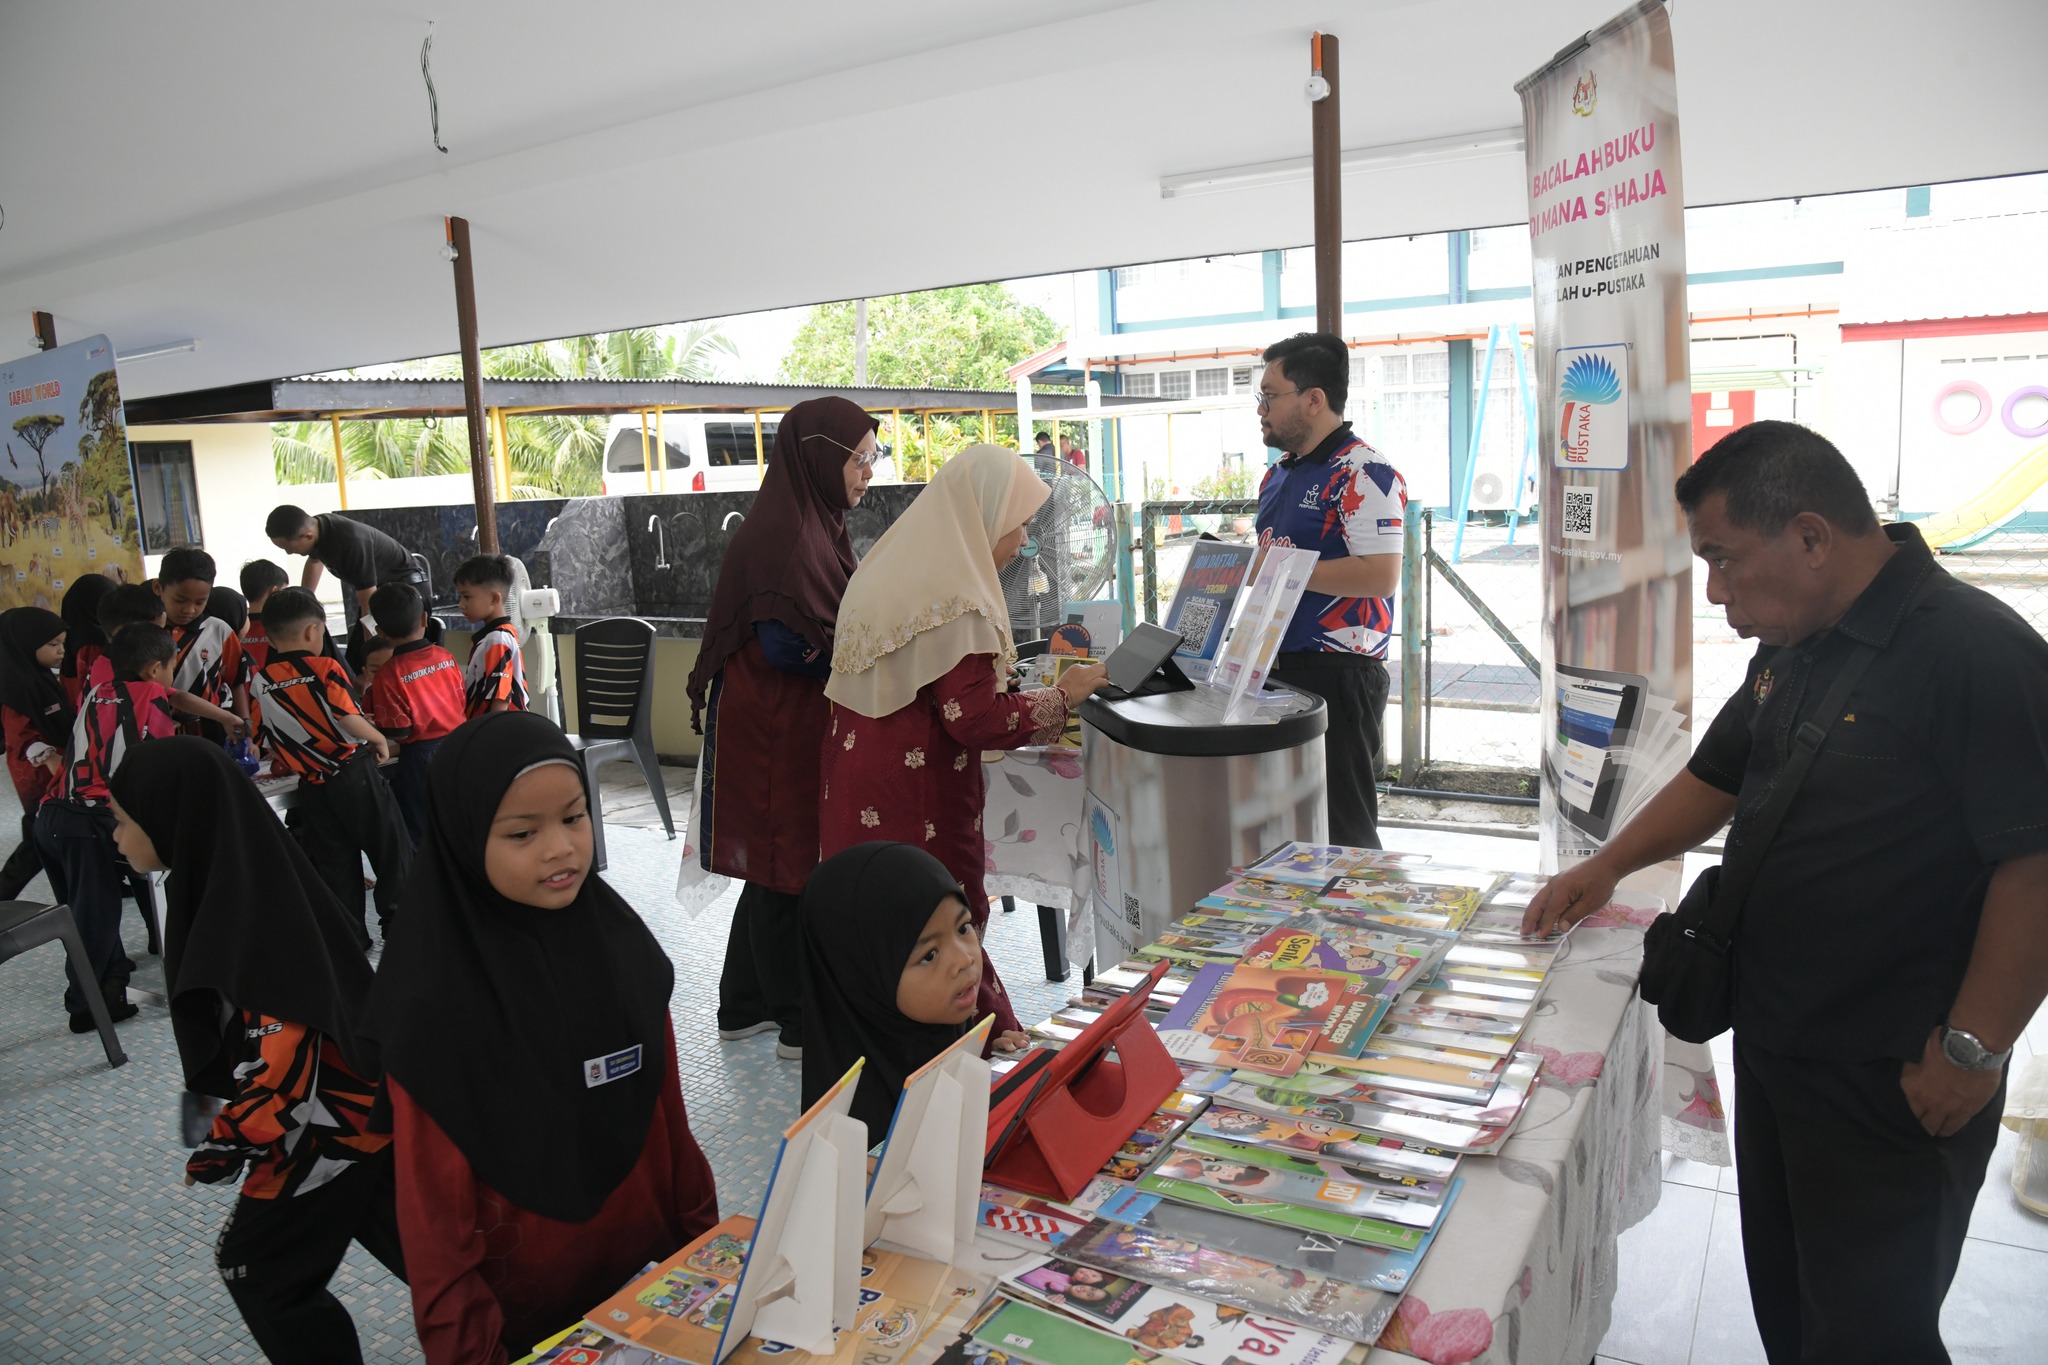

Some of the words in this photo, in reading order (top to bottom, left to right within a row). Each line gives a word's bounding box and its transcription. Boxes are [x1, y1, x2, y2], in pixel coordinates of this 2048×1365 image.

[1541, 196, 1588, 234] MANA
[1594, 169, 1667, 217] SAHAJA
[1575, 243, 1660, 276] PENGETAHUAN
[1582, 273, 1645, 298] u-PUSTAKA
[34, 380, 61, 400] WORLD
[1577, 404, 1592, 463] PUSTAKA
[1208, 554, 1239, 568] DAFTAR
[1191, 596, 1206, 604] SCAN
[262, 675, 316, 694] PASIFIK
[1211, 971, 1234, 997] Tubuh
[1186, 995, 1218, 1027] Manusia
[1340, 1001, 1367, 1024] DARK
[1328, 1022, 1353, 1044] DEER
